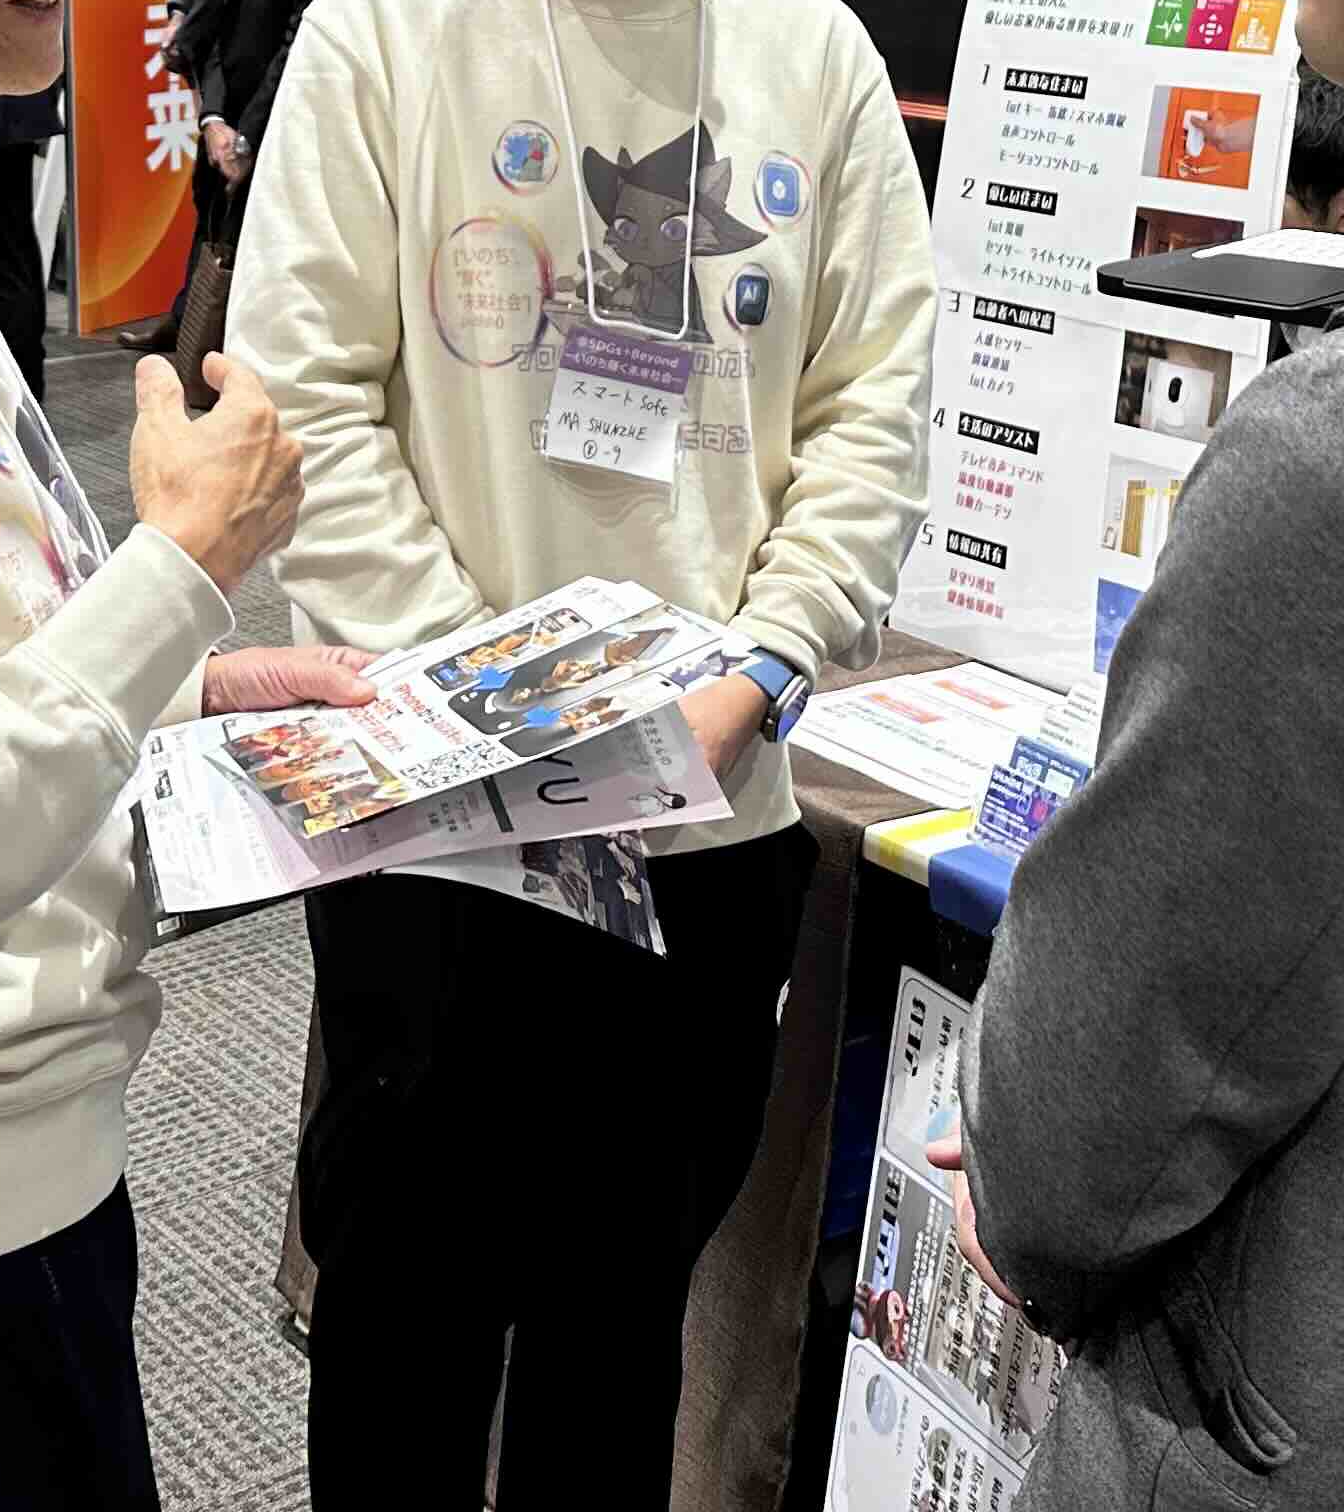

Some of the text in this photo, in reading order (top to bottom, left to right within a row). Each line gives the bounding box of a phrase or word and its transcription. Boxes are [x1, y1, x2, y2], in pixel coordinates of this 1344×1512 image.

[961, 178, 975, 199] 2
[572, 381, 669, 417] スマート Soft
[932, 408, 1034, 448] 4 生活のアシスト
[920, 522, 935, 546] 5
